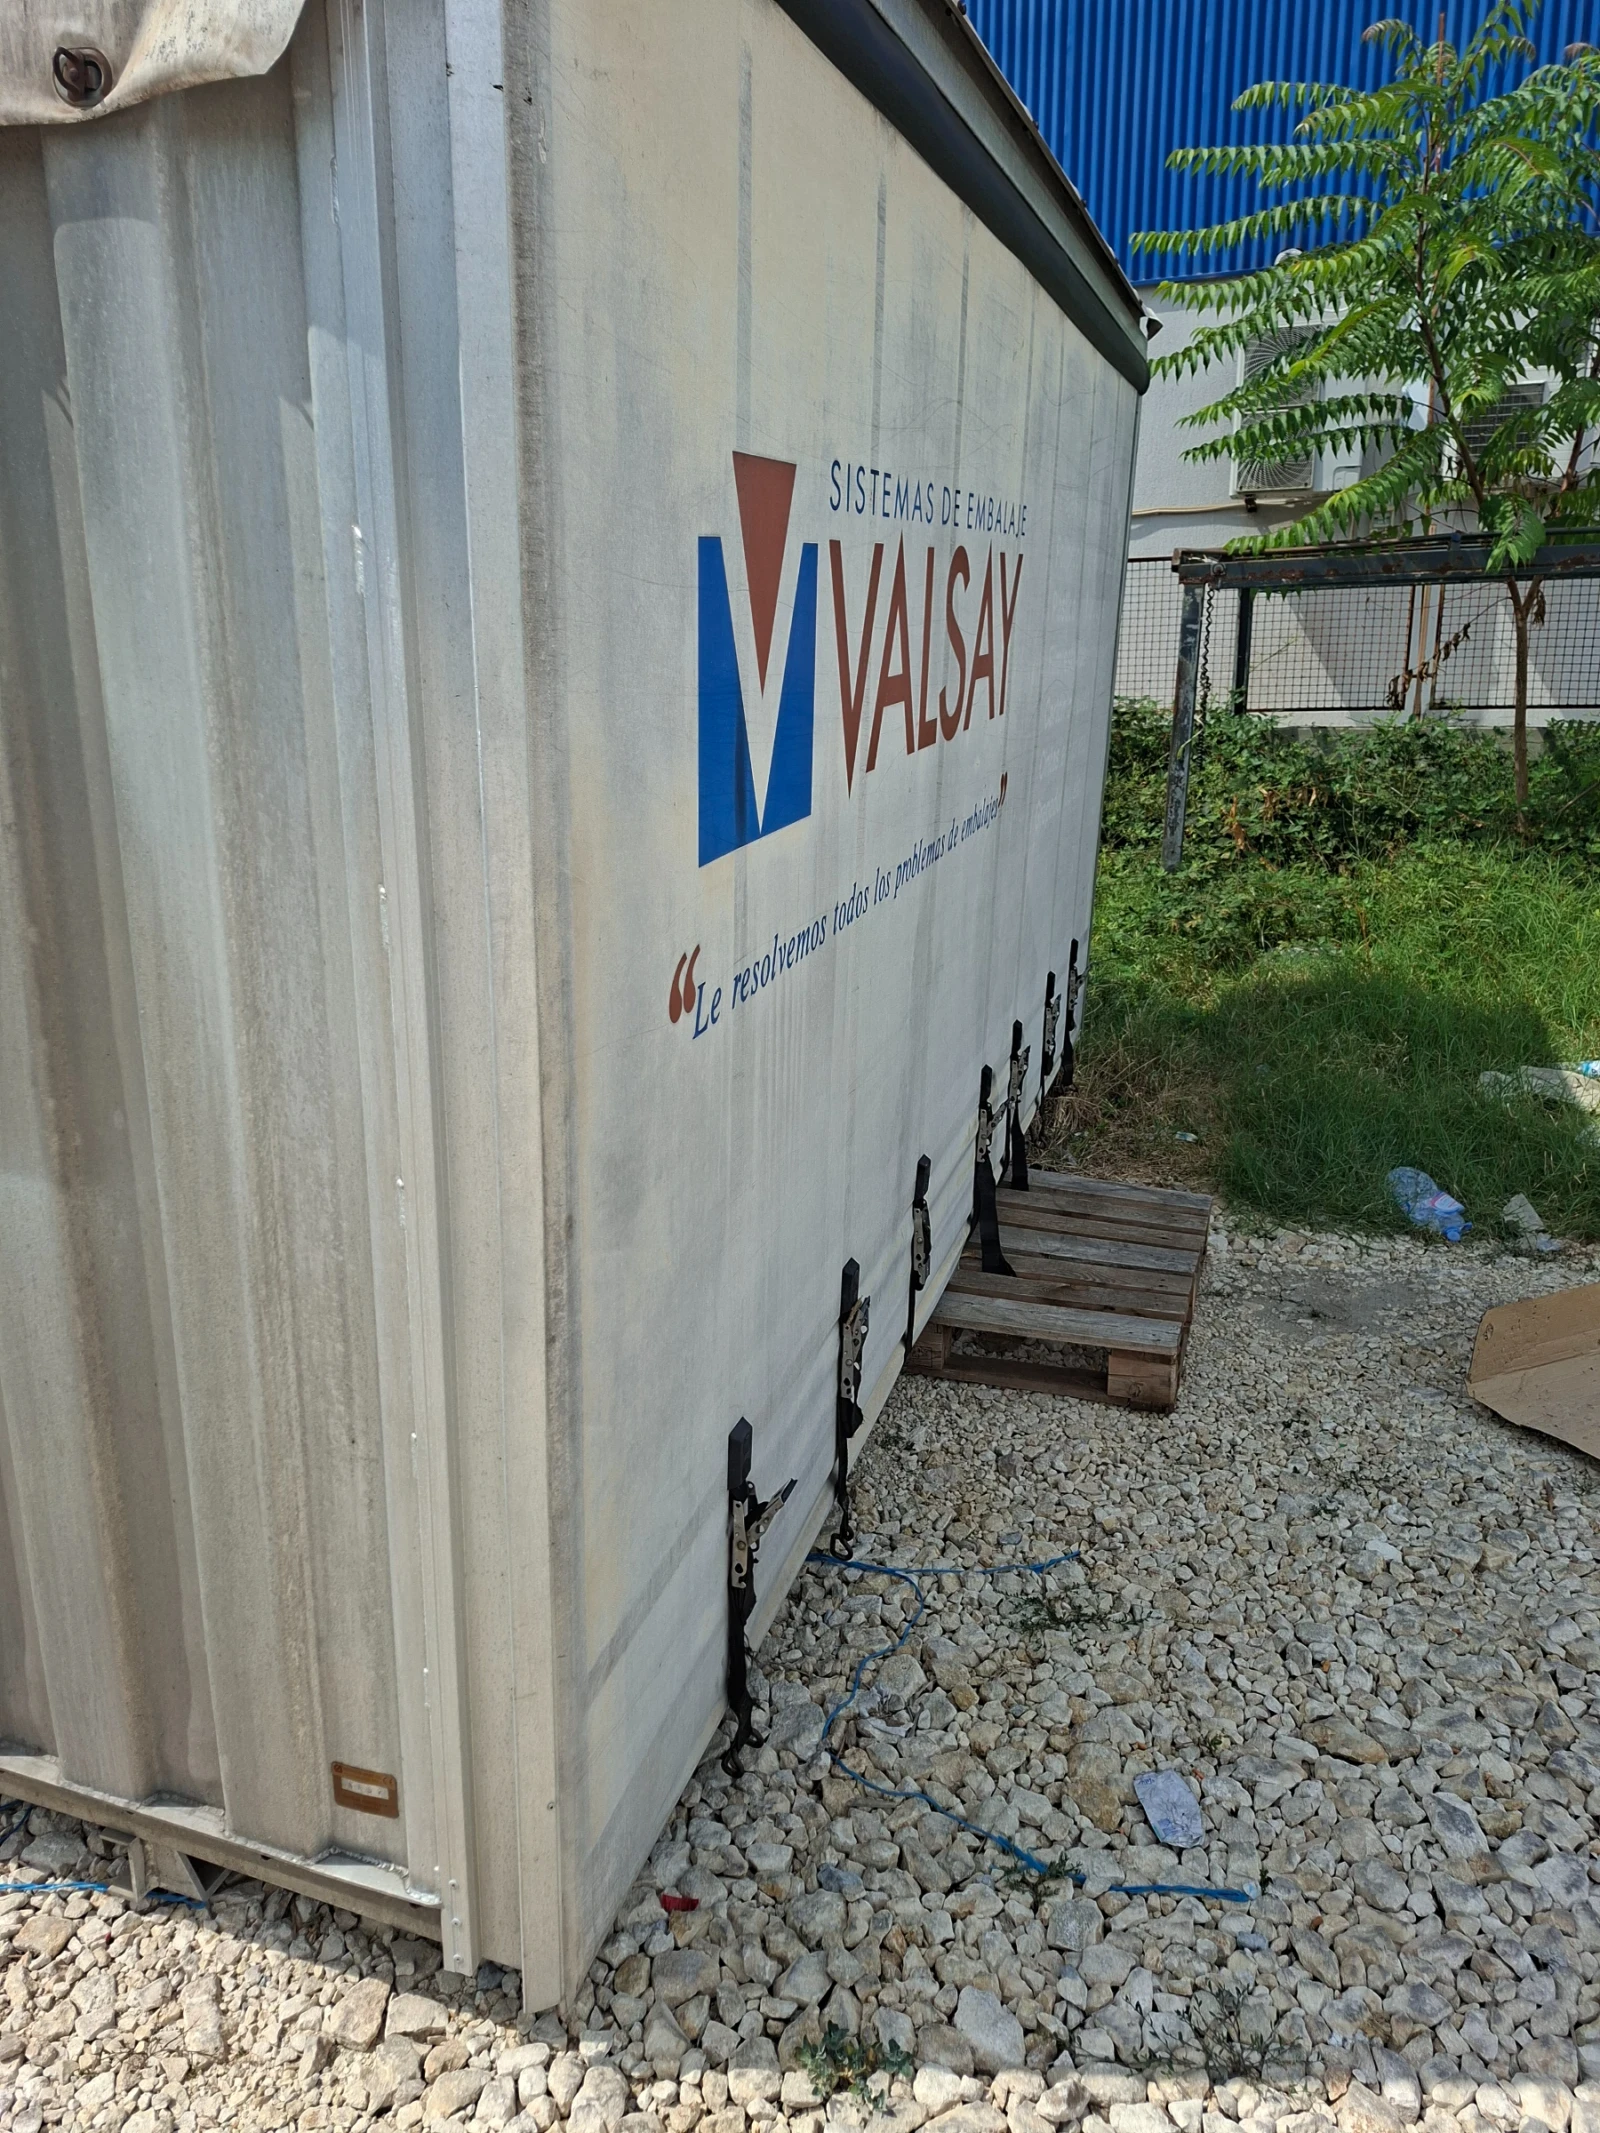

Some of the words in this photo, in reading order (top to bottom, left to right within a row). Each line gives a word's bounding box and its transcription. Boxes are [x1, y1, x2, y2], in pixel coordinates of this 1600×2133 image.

[829, 460, 934, 524] SISTEMAS
[941, 486, 961, 527] DE
[967, 492, 1027, 538] EMBALAJE
[829, 528, 1024, 800] VALSAY
[732, 914, 827, 1010] resolvemos
[833, 882, 869, 936] todos
[873, 866, 891, 905] los
[894, 838, 945, 900] problemas
[947, 817, 959, 851] de
